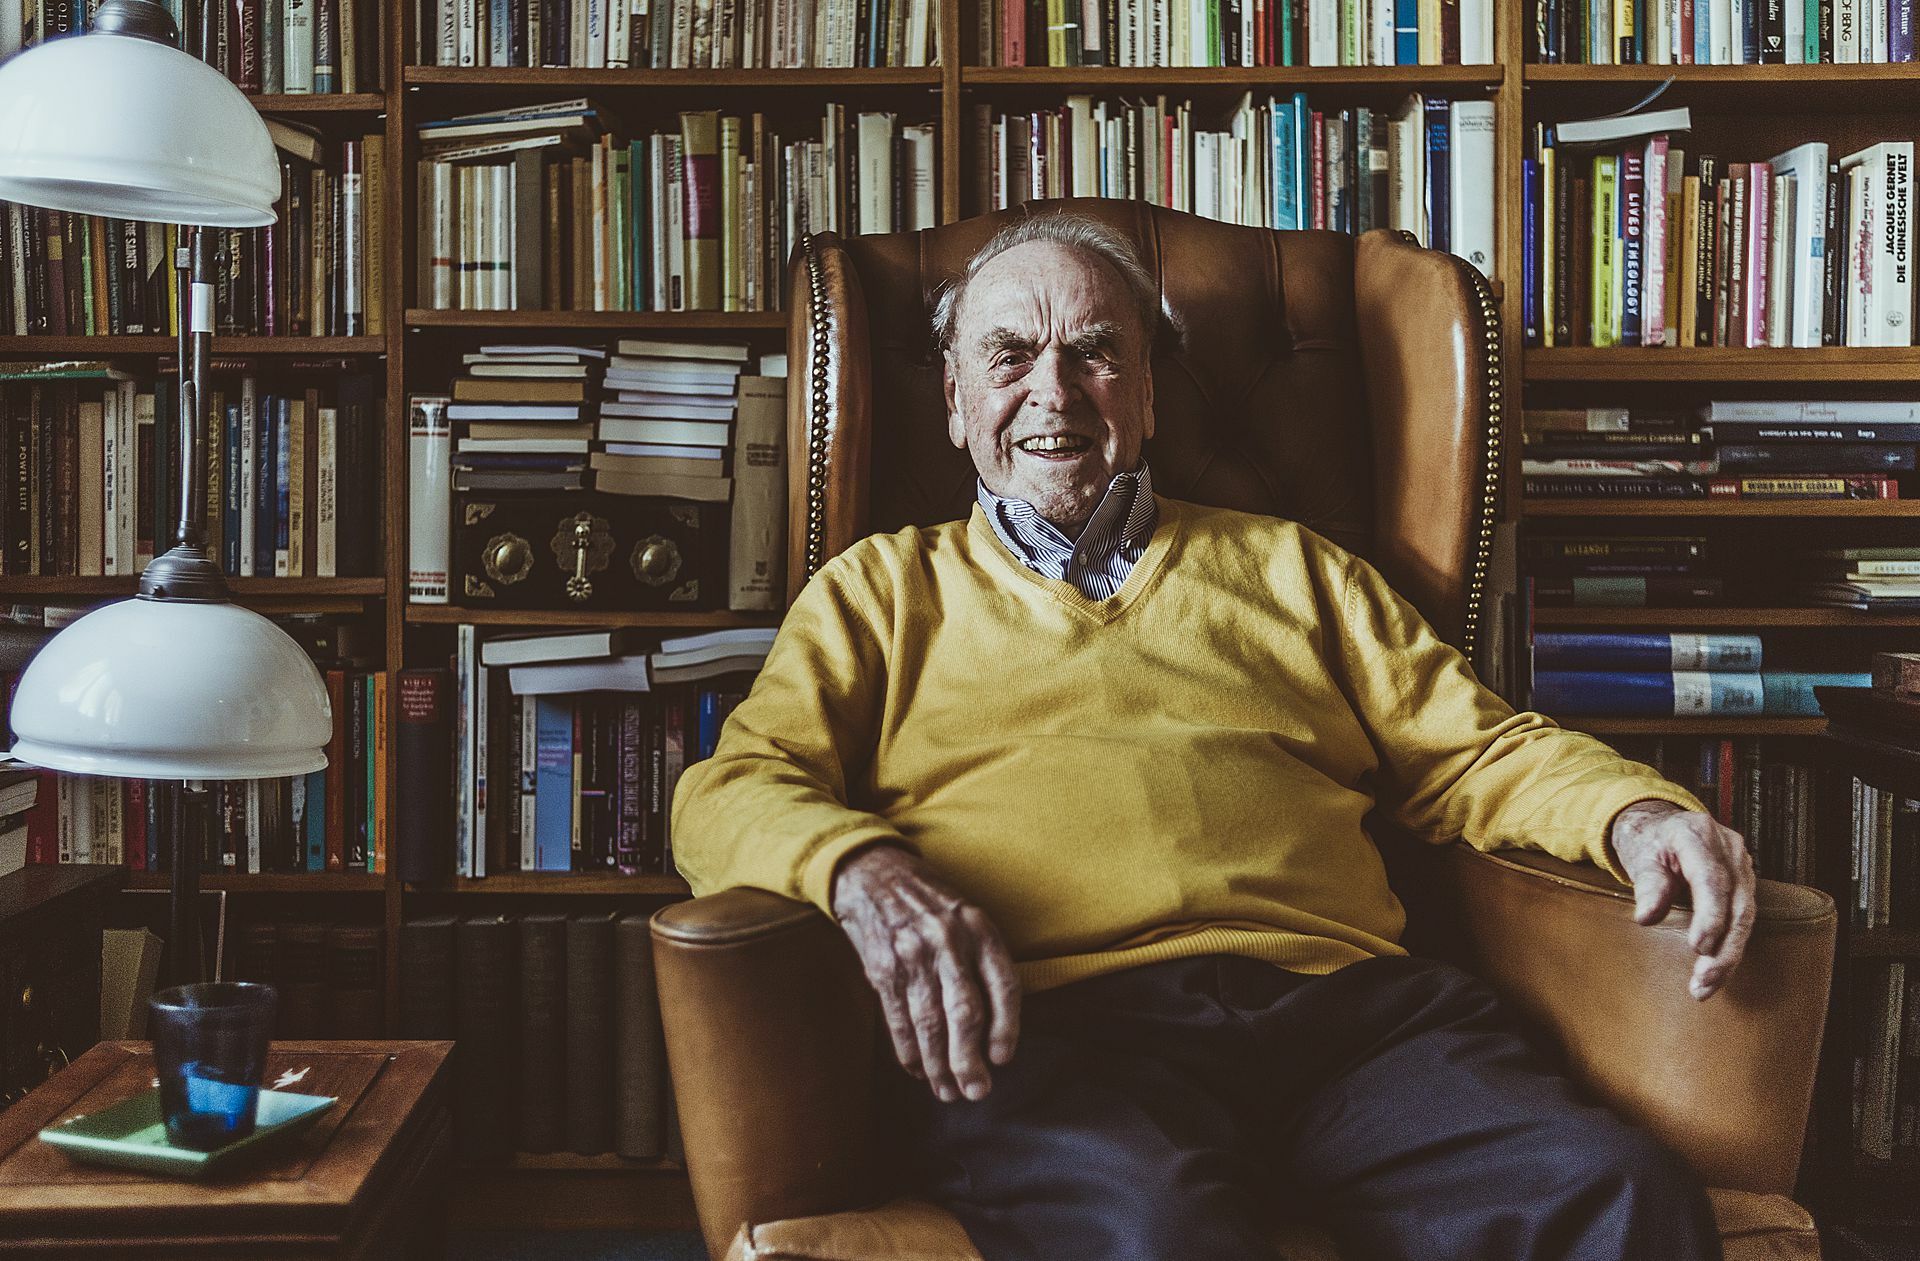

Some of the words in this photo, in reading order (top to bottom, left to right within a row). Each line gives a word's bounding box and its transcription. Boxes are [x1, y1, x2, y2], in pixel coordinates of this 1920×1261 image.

[244, 6, 254, 75] IMAGINATION
[1841, 13, 1852, 42] BEING
[1901, 7, 1911, 35] Future
[1886, 154, 1896, 201] GERNET
[1897, 154, 1907, 185] WELT
[125, 222, 137, 239] THE
[1628, 192, 1640, 236] LIVED
[1886, 204, 1896, 255] JACQUES
[1896, 187, 1907, 262] CHINESISCHE
[125, 239, 137, 269] SAINTS
[1626, 239, 1640, 315] THEOLOGY
[1897, 265, 1907, 283] DIE
[19, 446, 27, 480] POWER
[19, 486, 27, 512] ELITE
[207, 473, 219, 518] SPIRIT
[652, 749, 664, 813] Examinations
